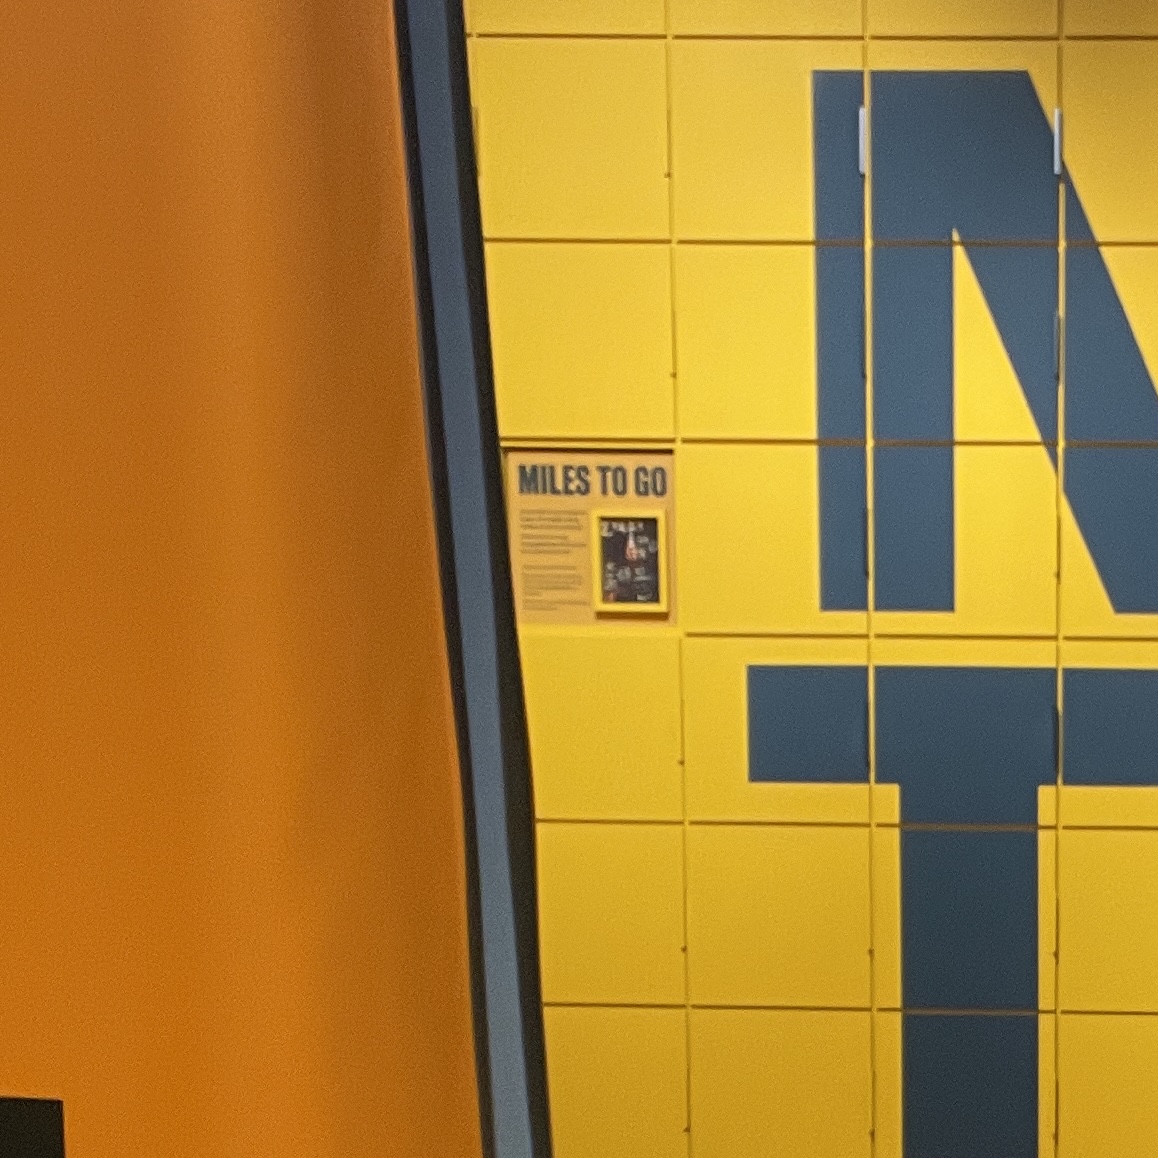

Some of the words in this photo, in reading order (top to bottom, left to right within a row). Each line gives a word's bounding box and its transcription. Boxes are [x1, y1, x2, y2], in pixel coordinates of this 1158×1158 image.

[518, 464, 591, 496] MILES
[596, 465, 628, 497] TO
[634, 465, 667, 497] GO
